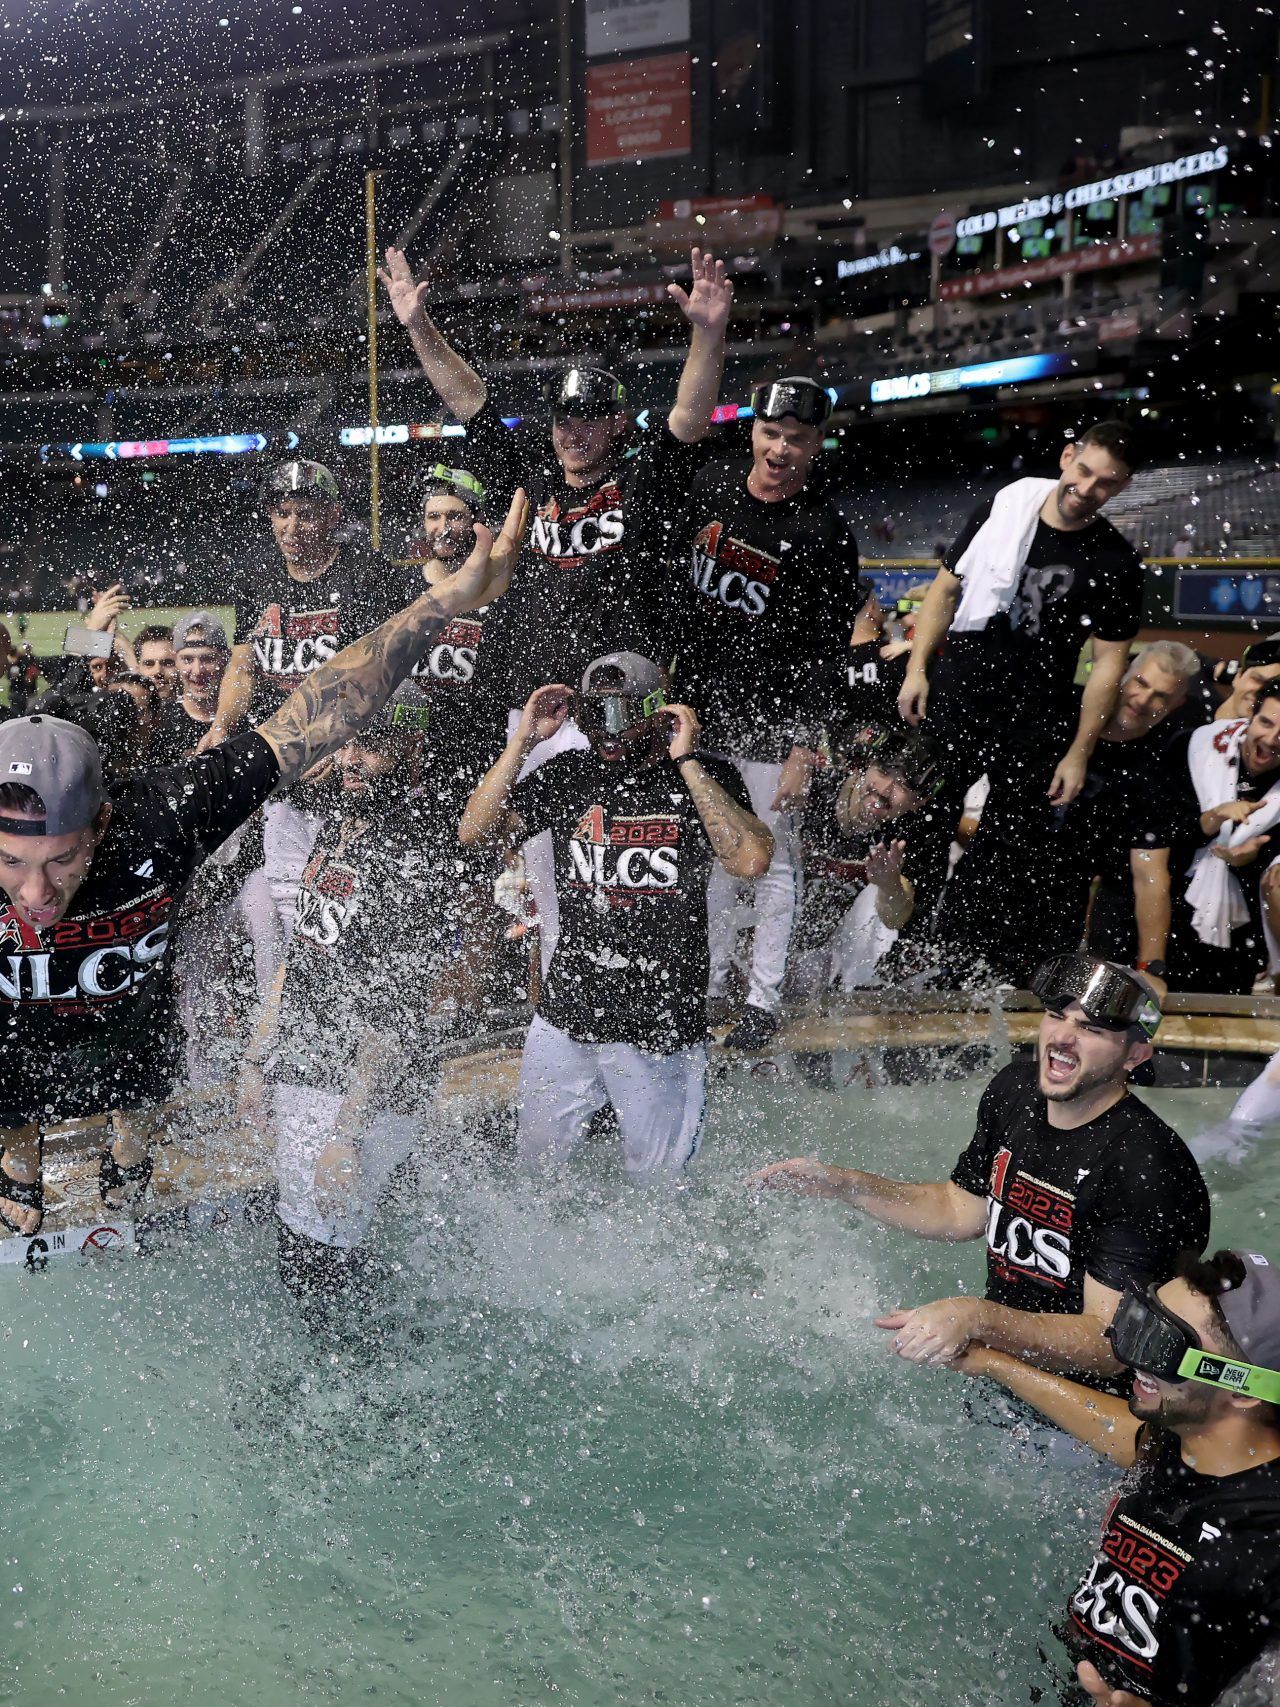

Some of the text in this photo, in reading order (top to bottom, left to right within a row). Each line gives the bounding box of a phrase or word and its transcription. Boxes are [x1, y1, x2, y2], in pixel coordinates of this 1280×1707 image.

[956, 211, 998, 238] COLD
[1065, 146, 1229, 209] CHEESEBURGERS
[531, 509, 625, 557] NLCS
[690, 552, 770, 615] NLCS
[610, 824, 679, 841] 2023
[568, 839, 679, 888] NLCS
[1008, 1182, 1073, 1229] 2023
[53, 1234, 66, 1250] IN
[985, 1196, 1071, 1279] LCS
[1223, 1374, 1243, 1385] ERA
[1226, 1367, 1245, 1379] NEW
[1103, 1529, 1180, 1592] 2023
[1119, 1513, 1192, 1562] ARIZONA DIAMONDBACKS
